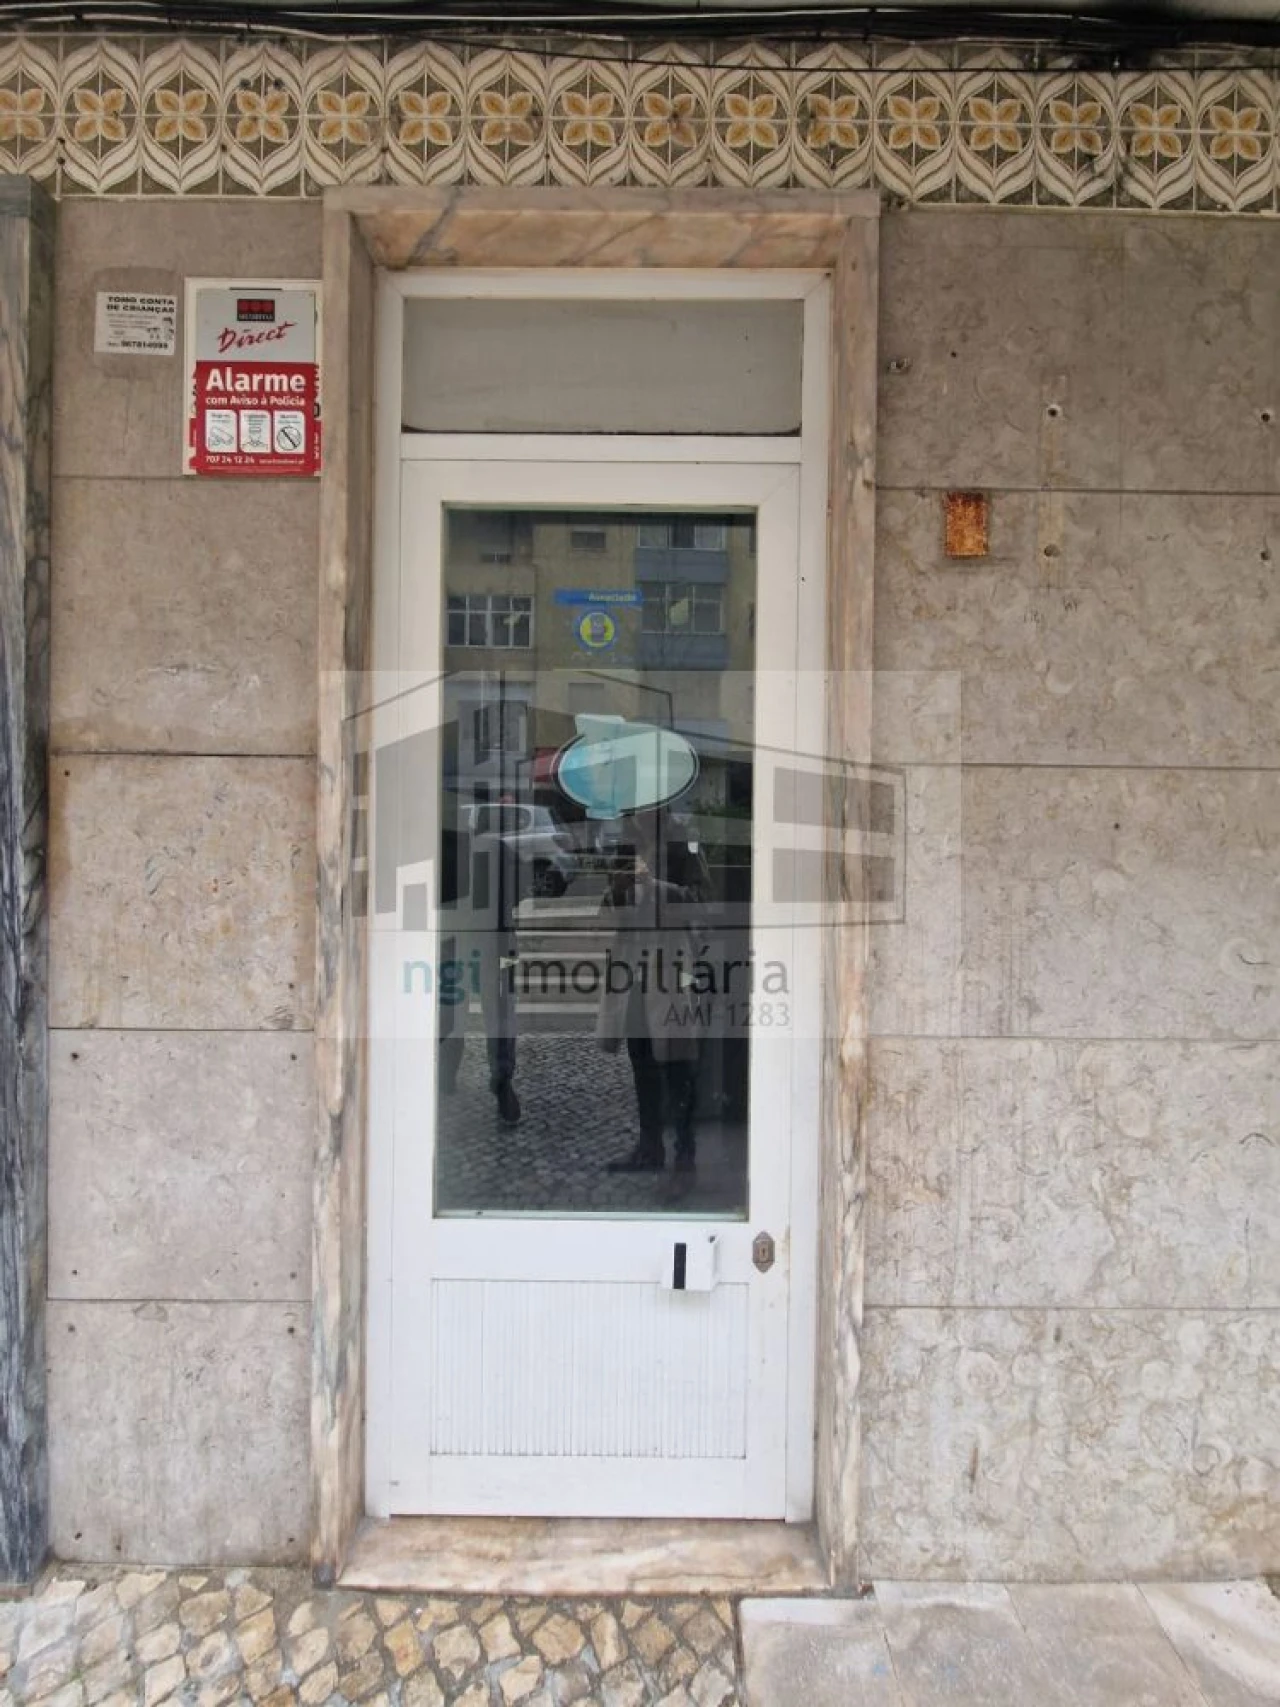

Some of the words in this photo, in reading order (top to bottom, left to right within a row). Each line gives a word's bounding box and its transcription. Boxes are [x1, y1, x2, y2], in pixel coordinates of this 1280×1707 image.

[122, 305, 175, 314] CRIANÇAS
[217, 321, 298, 353] Direct
[206, 367, 306, 392] Alarme
[205, 396, 228, 405] com
[230, 394, 258, 405] Aviso
[269, 394, 305, 406] Polícia
[205, 455, 219, 464] 707
[221, 455, 232, 464] 24
[233, 455, 243, 464] 12
